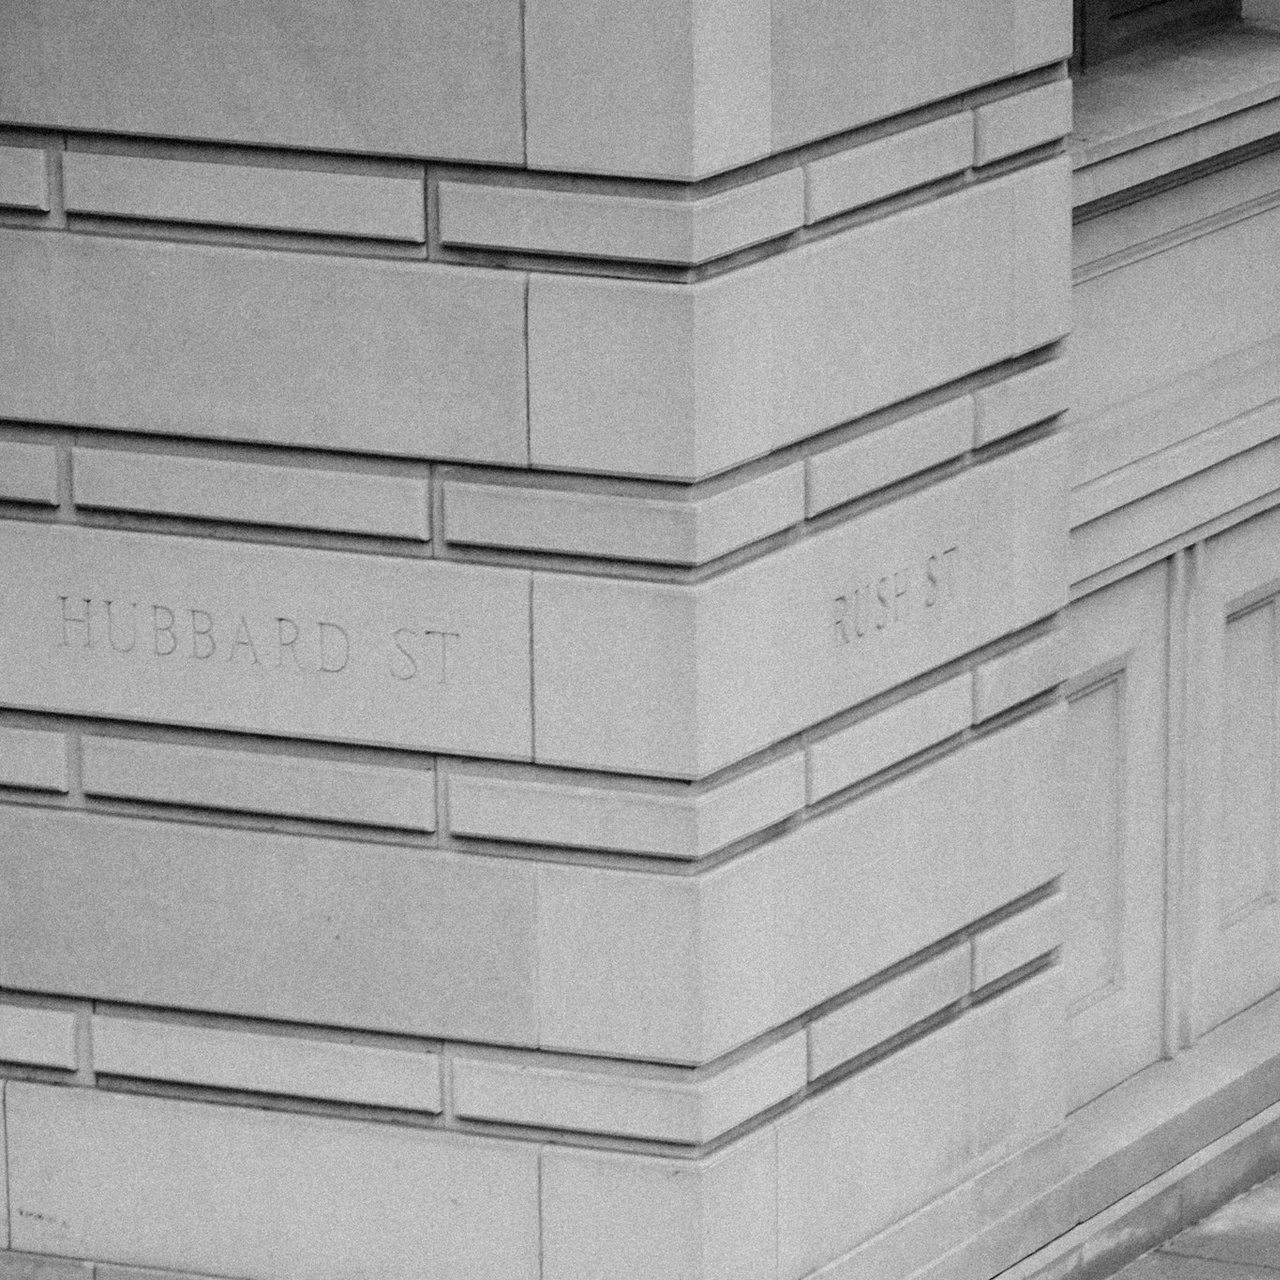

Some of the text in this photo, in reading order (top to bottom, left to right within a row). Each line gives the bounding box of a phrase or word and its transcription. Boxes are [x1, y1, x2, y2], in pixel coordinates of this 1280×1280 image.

[923, 544, 959, 608] ST
[55, 594, 461, 685] HUBBARD ST
